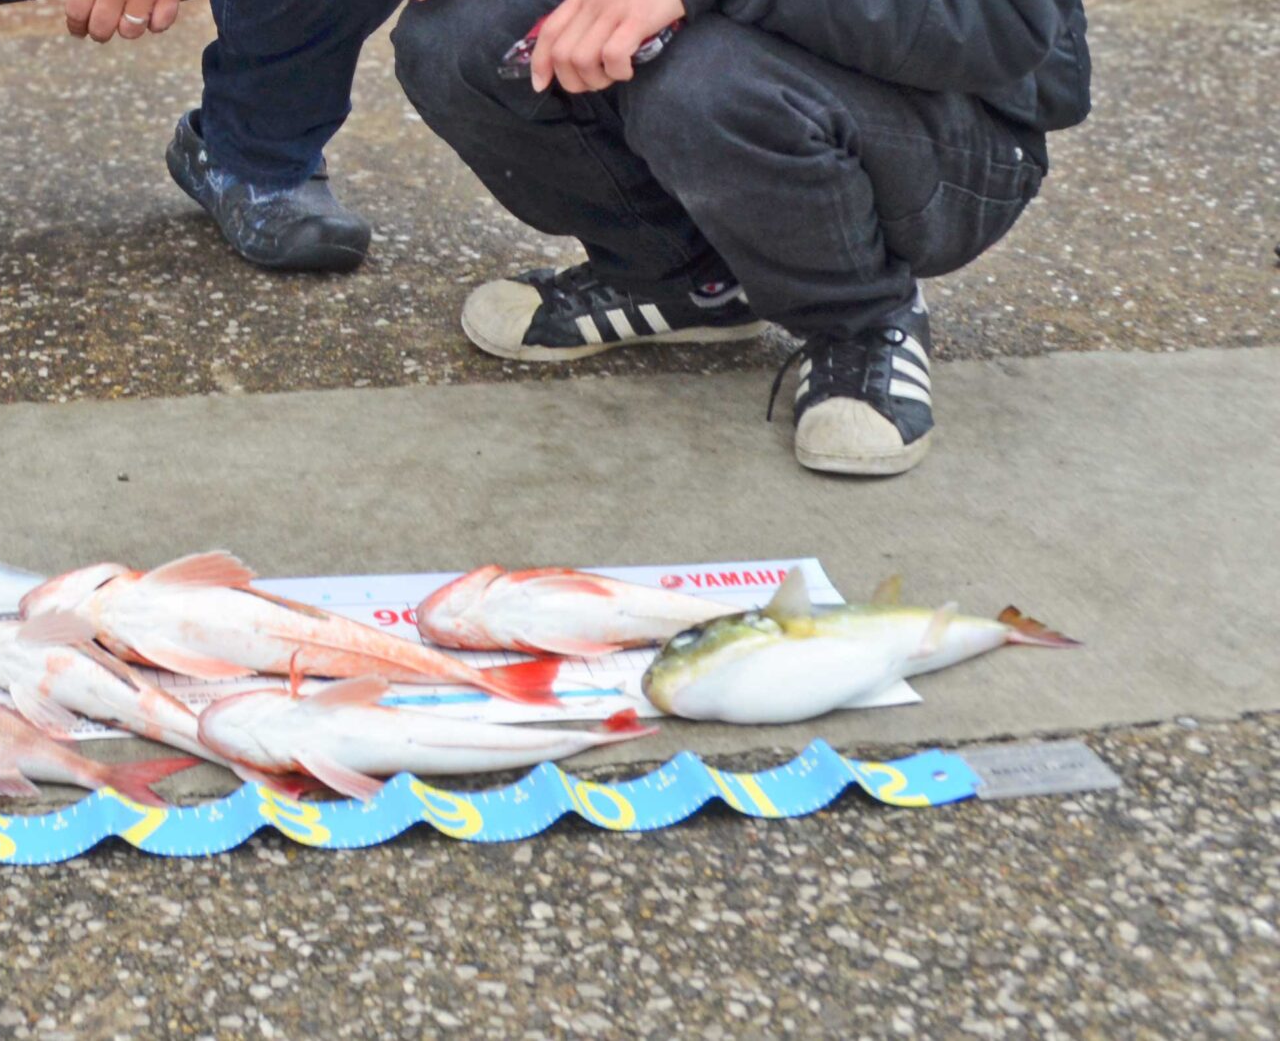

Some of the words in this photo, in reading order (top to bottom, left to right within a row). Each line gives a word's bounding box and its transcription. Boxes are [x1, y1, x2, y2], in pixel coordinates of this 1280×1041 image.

[100, 786, 168, 846] 7
[257, 784, 331, 847] 8
[409, 779, 483, 840] 9
